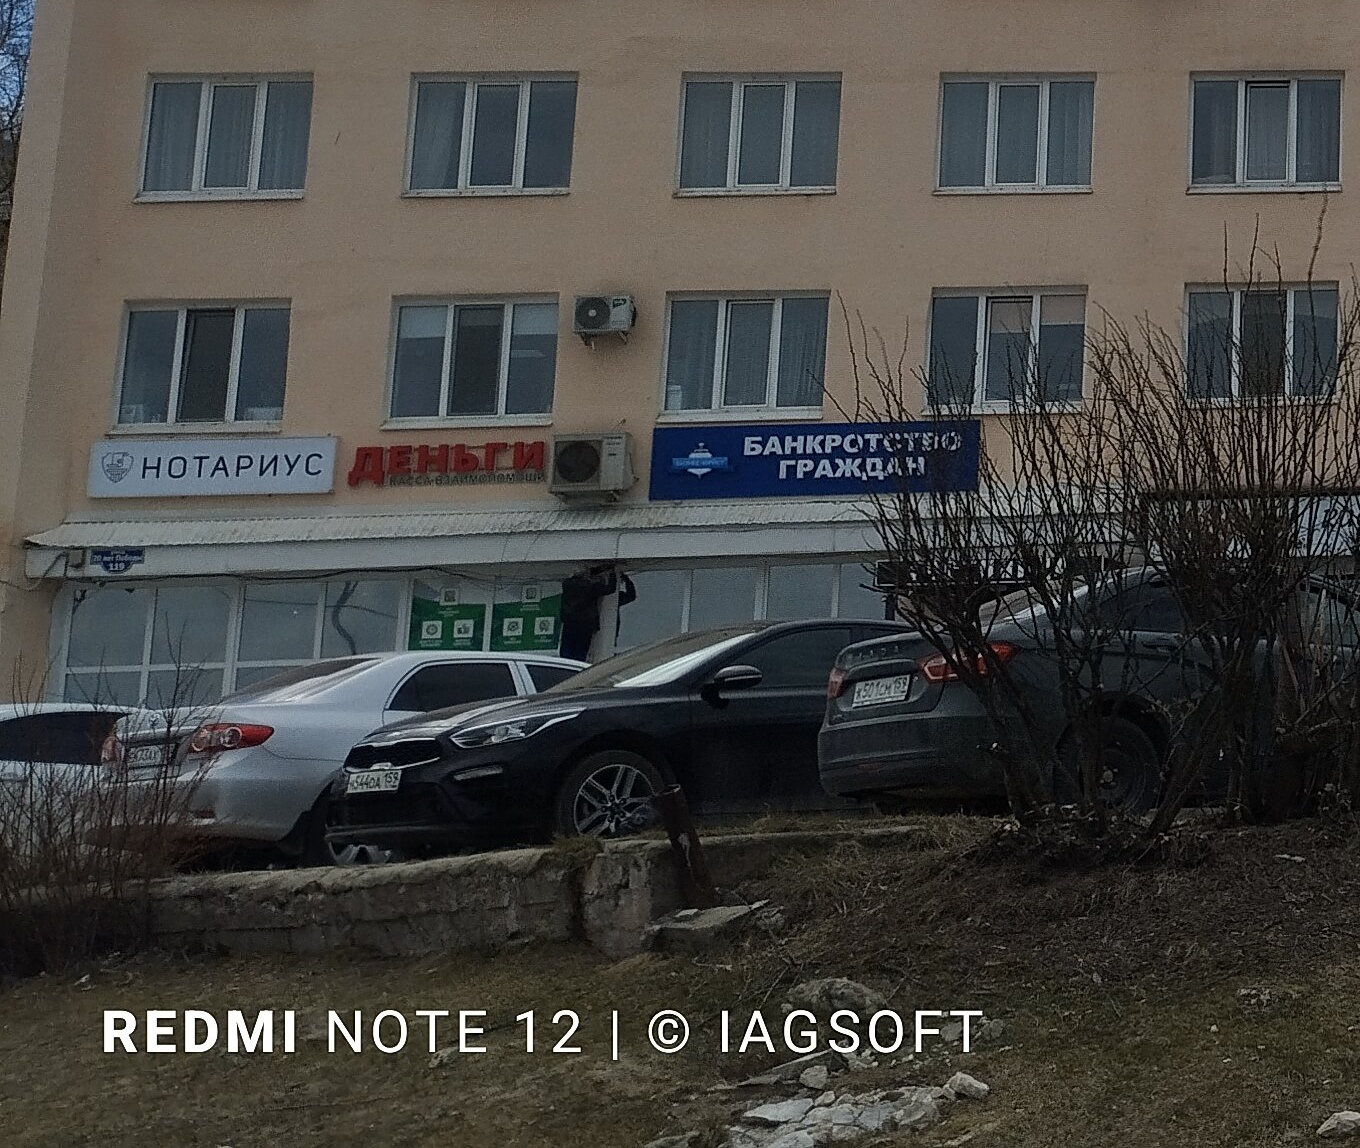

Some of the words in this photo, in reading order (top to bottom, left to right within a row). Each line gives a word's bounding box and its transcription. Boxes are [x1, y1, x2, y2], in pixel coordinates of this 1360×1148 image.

[743, 431, 962, 457] БАНКРОТСТВО
[141, 453, 324, 480] НОТАРИУС
[347, 440, 545, 488] ДЕНЬГИ
[778, 456, 927, 481] ГРАЖДАН
